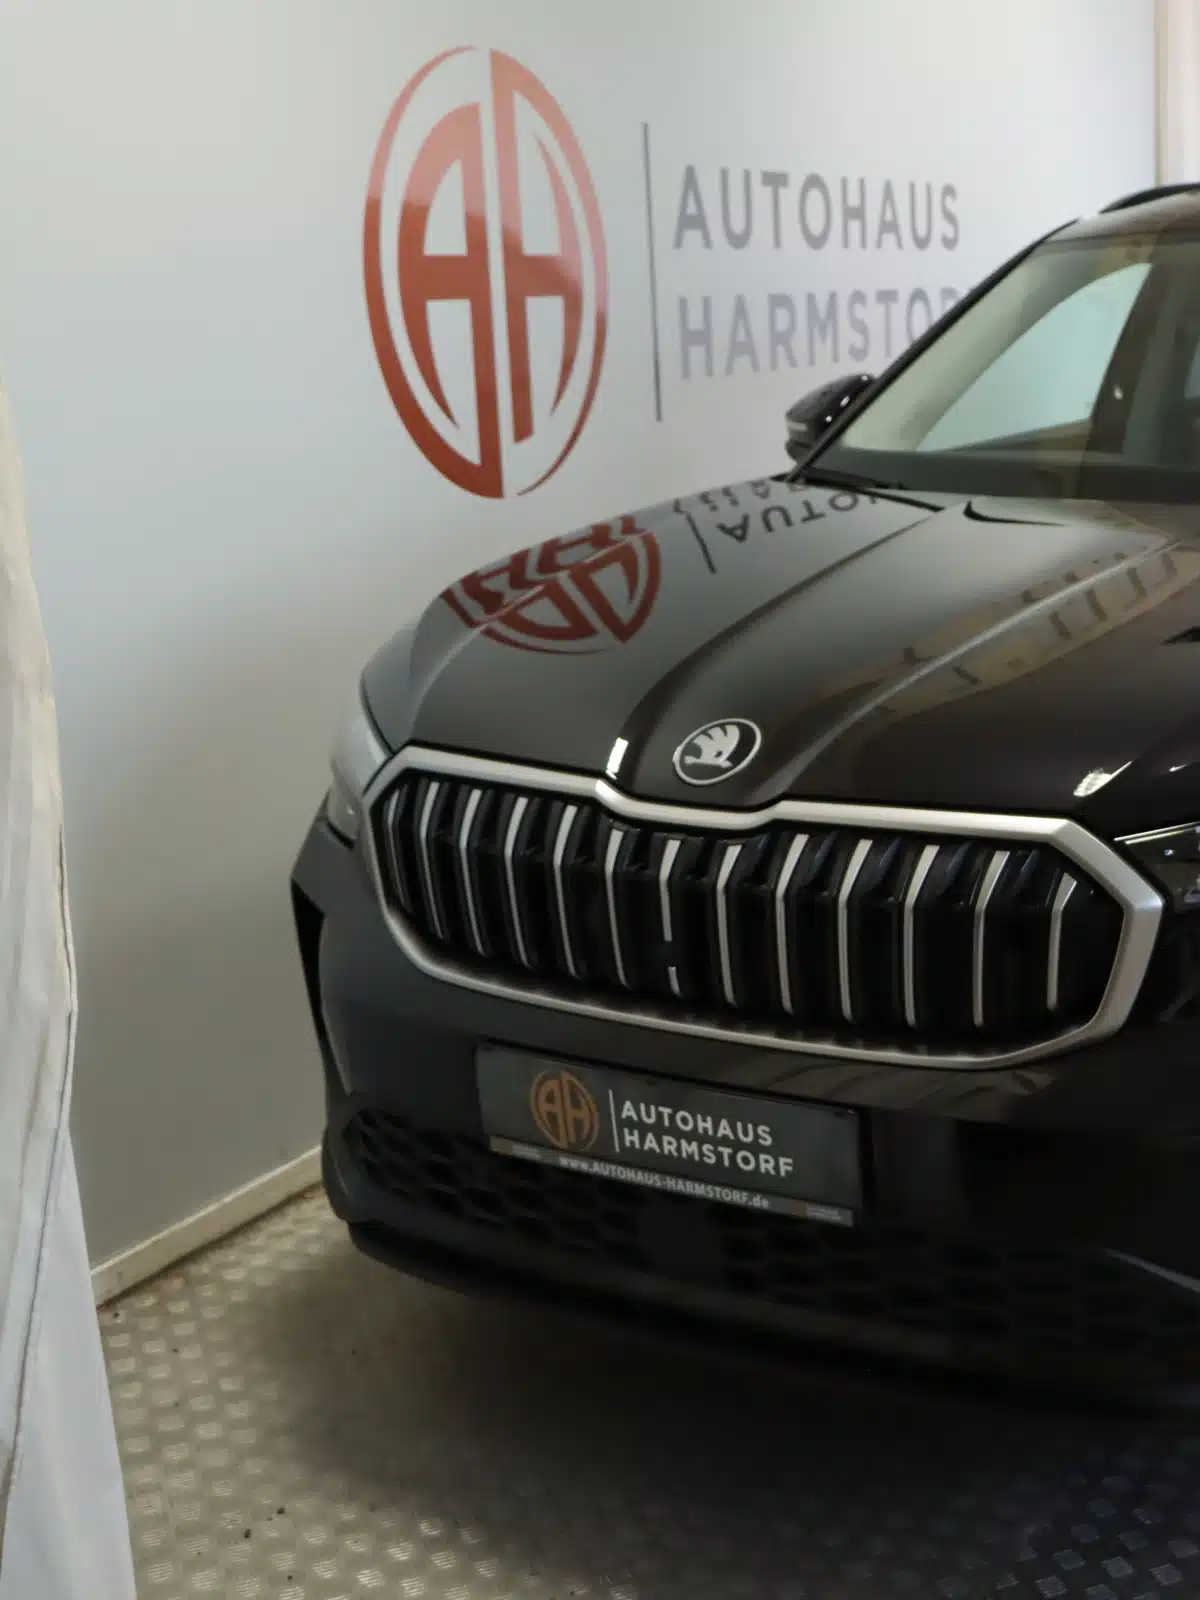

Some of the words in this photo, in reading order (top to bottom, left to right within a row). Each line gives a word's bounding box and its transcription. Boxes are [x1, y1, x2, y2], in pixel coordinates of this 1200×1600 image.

[674, 164, 960, 252] AUTOHAUS
[620, 1099, 773, 1147] AUTOHAUS
[623, 1129, 794, 1177] HARMSTORF
[559, 1156, 771, 1209] www.AUTOHAUS-HARMSTORF.de
